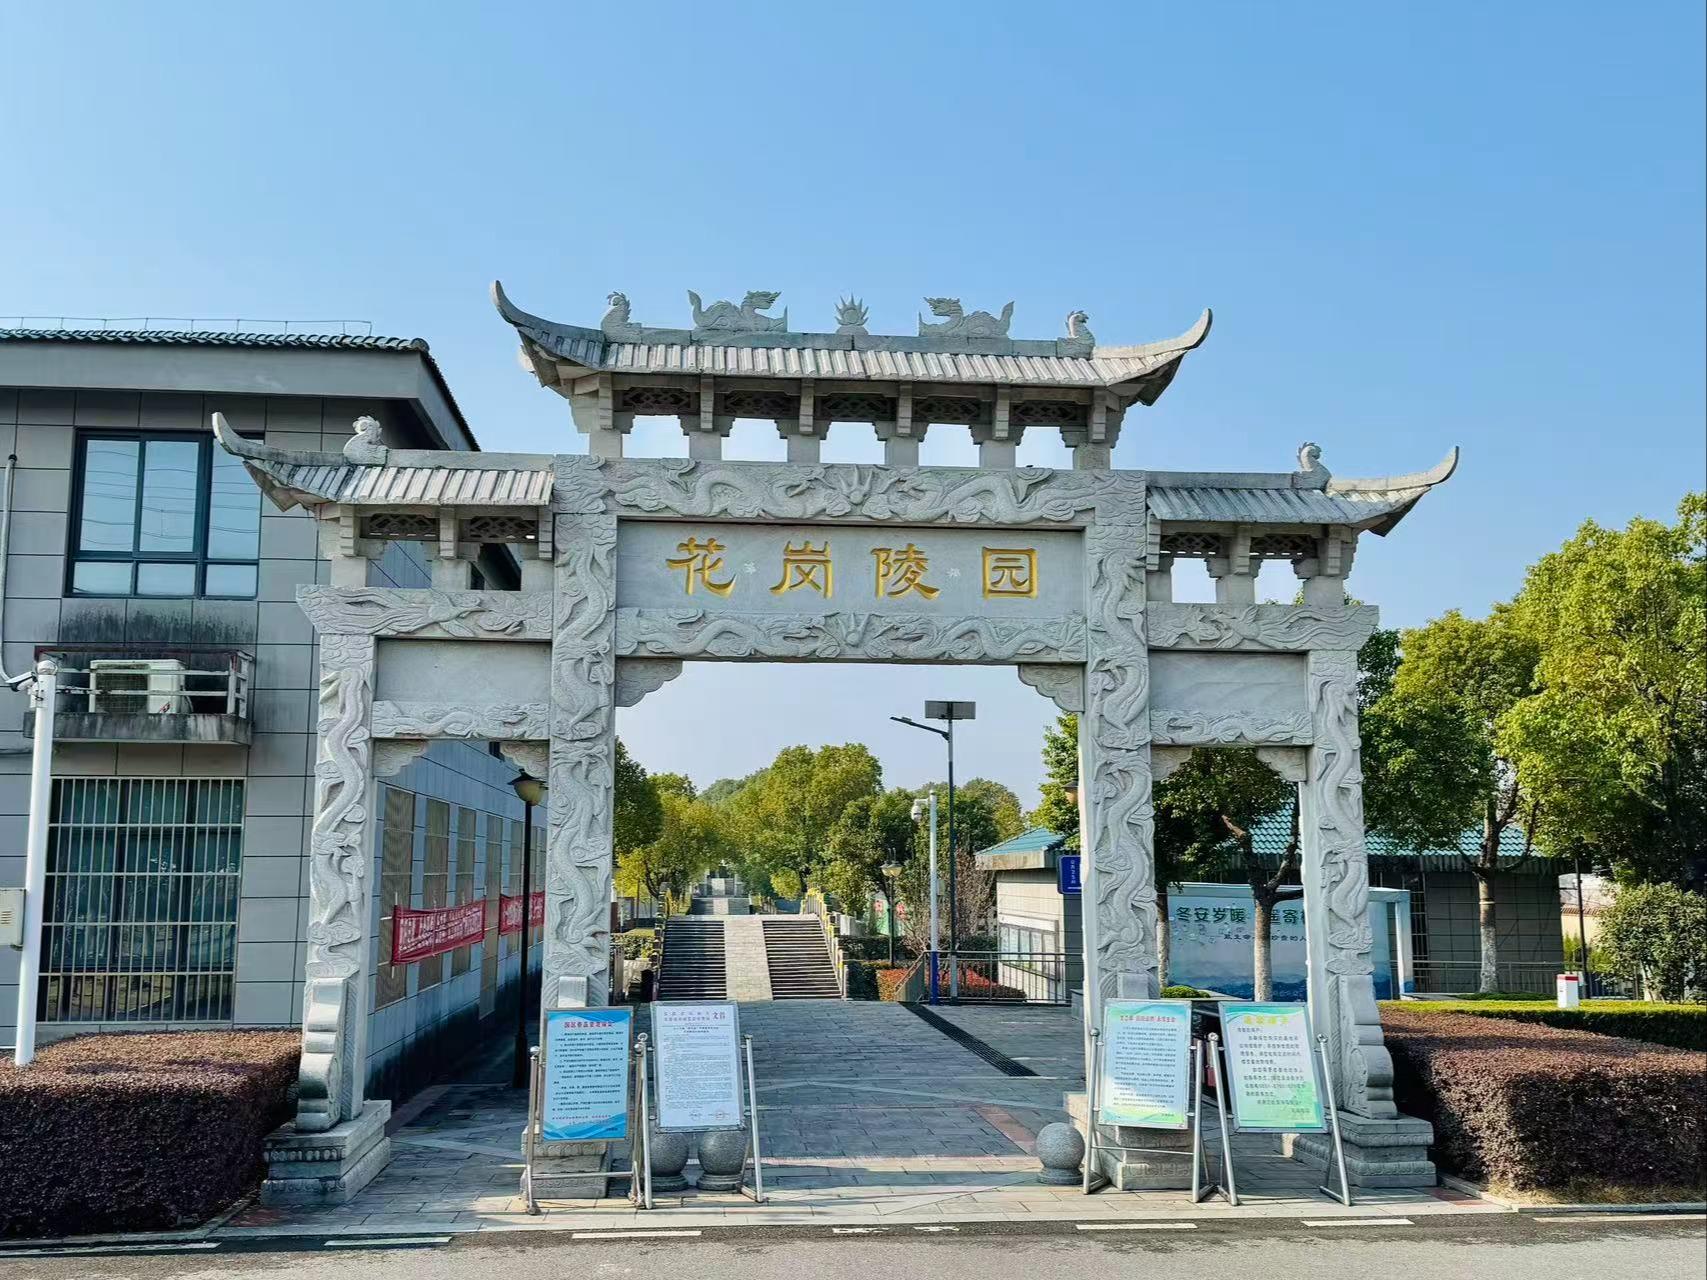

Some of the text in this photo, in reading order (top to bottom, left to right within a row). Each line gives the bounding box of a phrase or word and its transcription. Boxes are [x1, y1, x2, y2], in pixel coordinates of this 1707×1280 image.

[666, 536, 1038, 600] 花岗陵园
[1176, 907, 1305, 925] 冬安岁暖 遥寄
